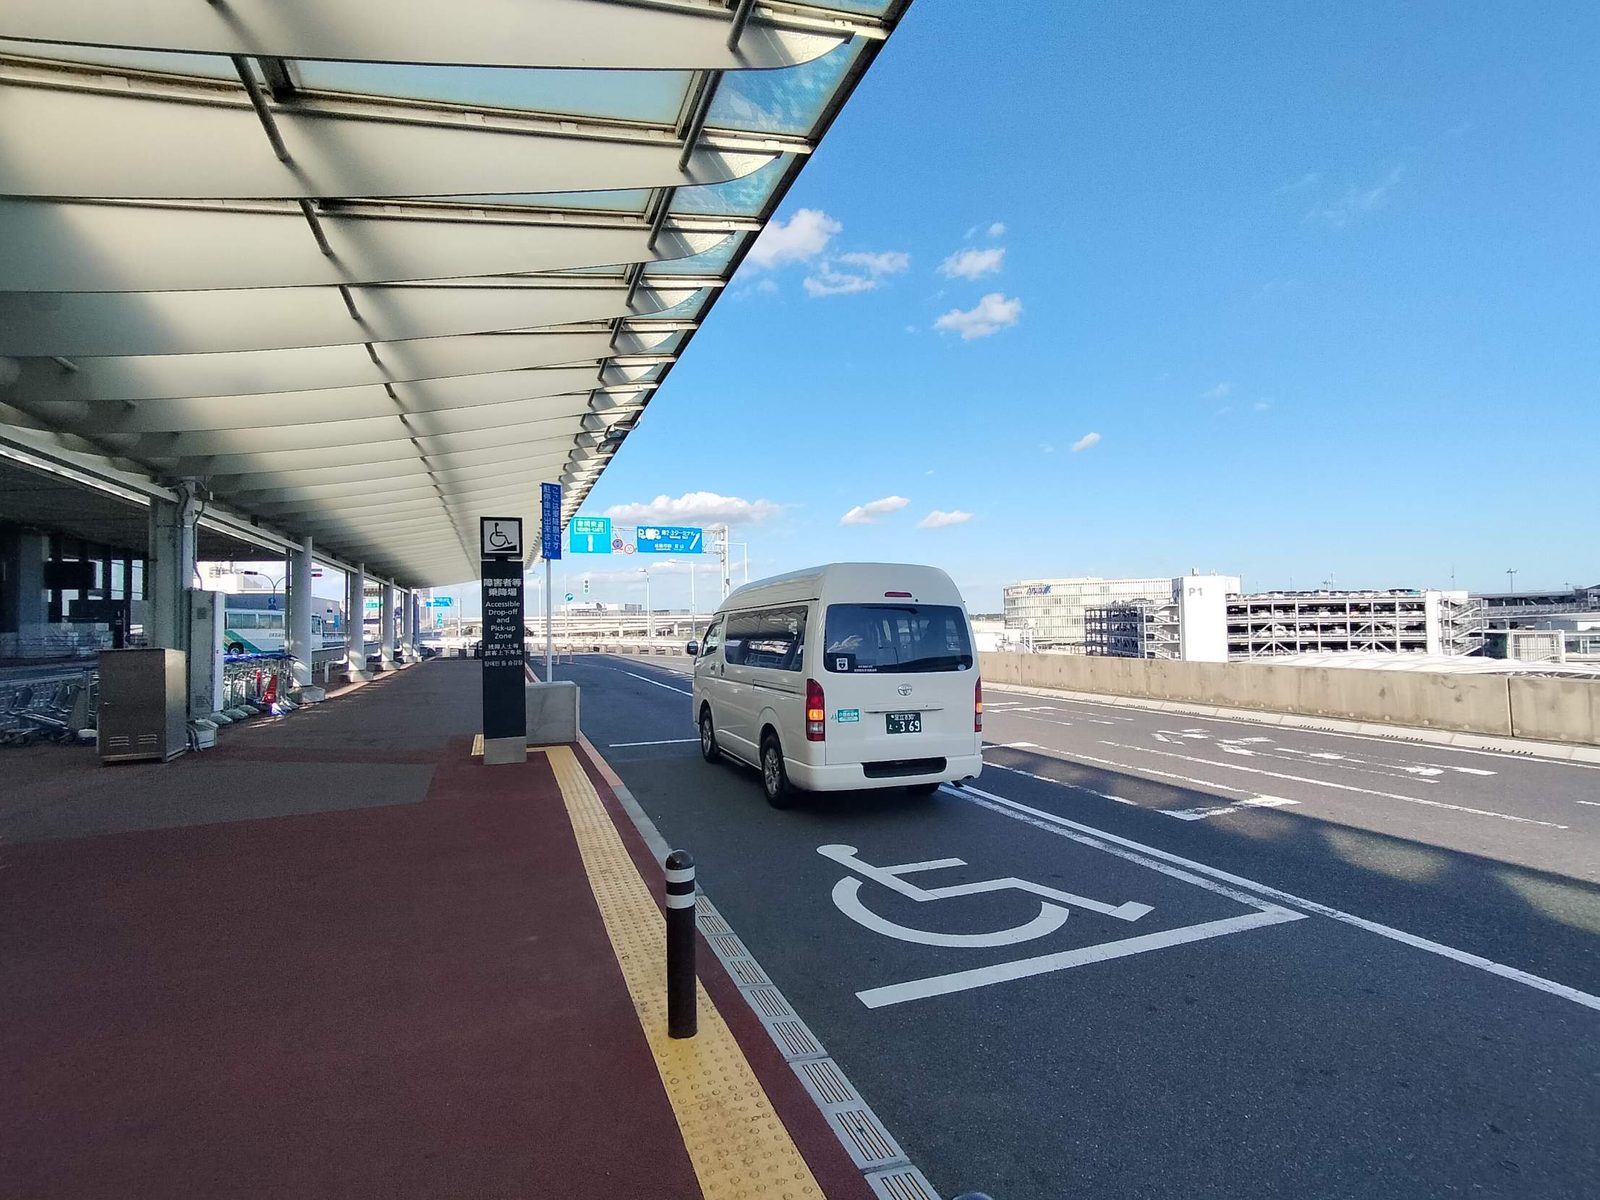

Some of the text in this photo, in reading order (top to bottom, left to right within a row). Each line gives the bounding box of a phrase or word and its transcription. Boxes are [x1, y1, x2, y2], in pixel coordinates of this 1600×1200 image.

[488, 587, 517, 597] 乗降場
[1188, 587, 1203, 597] P1
[485, 600, 521, 608] Accessible
[488, 608, 518, 616] Drop-off
[490, 624, 516, 632] Pick-up
[494, 632, 513, 640] Zone
